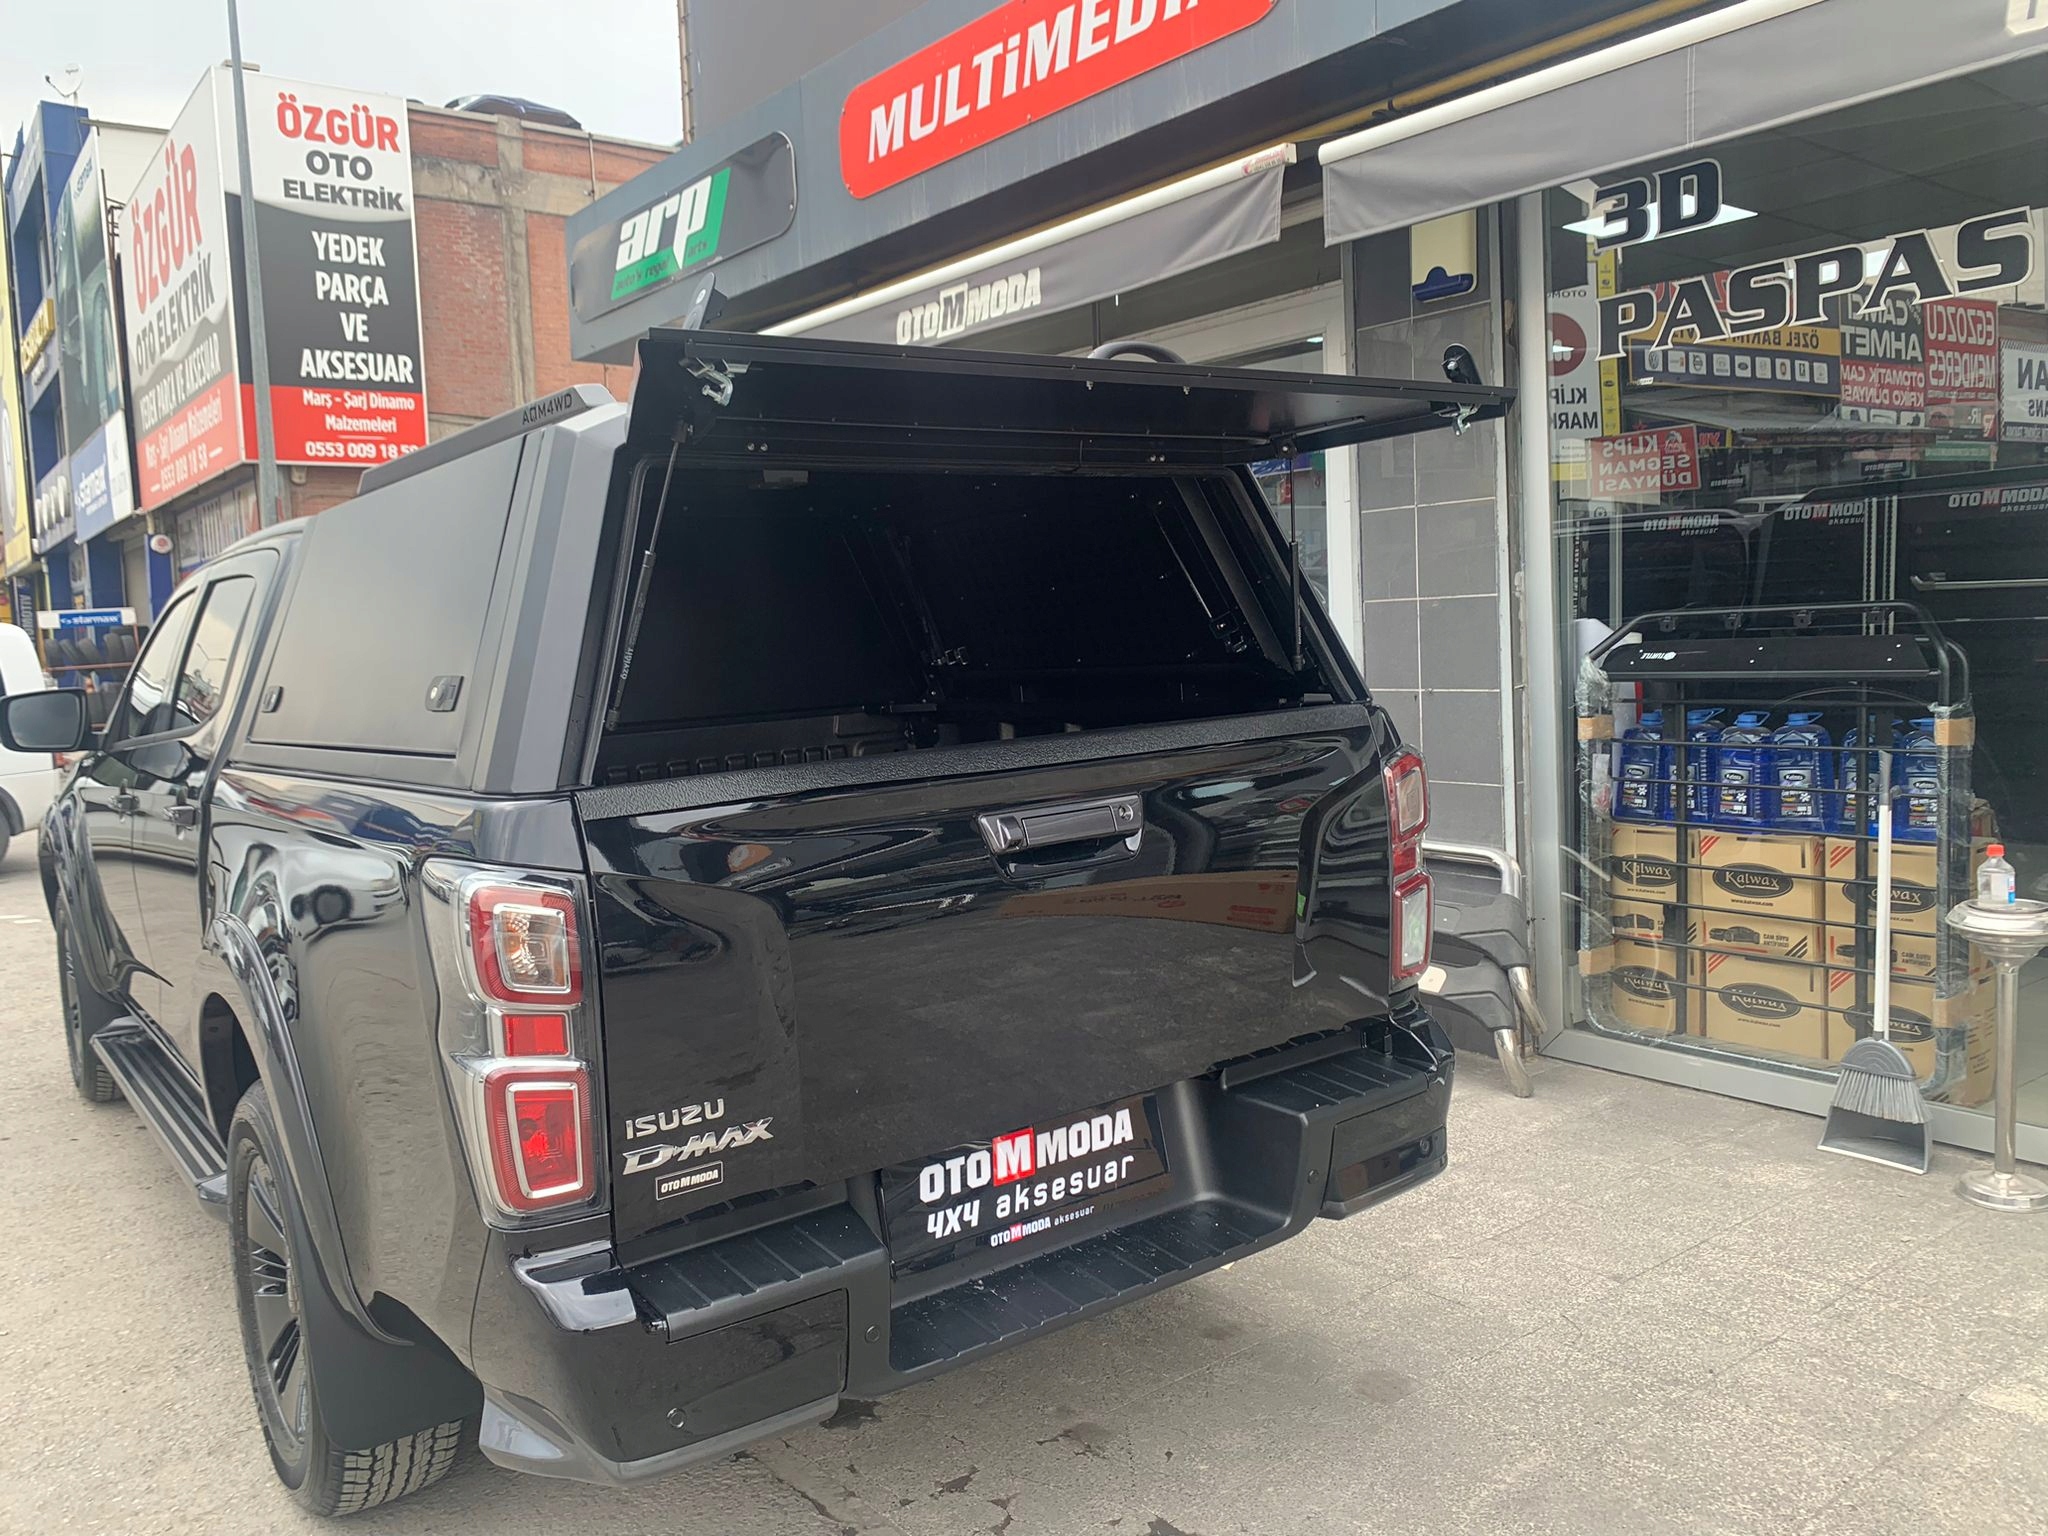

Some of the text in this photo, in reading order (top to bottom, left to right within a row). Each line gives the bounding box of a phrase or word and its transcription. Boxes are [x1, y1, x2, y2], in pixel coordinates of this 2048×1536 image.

[867, 0, 1200, 164] MULTiMED
[277, 92, 401, 153] ÖZGÜR
[305, 149, 373, 181] OTO
[283, 178, 404, 212] ELEKTRİK
[1592, 157, 1723, 254] 3D
[131, 139, 203, 315] ÖZGÜR
[615, 175, 712, 272] arp
[311, 230, 386, 267] YEDEK
[315, 270, 390, 309] PARÇA
[1594, 205, 2036, 361] PASPAS
[136, 251, 216, 376] OTO ELEKTRİK
[339, 312, 369, 343] VE
[300, 348, 415, 384] AKSESUAR
[302, 389, 333, 409] Marş
[343, 391, 369, 411] Şarj
[369, 392, 415, 411] Dinamo
[324, 414, 398, 433] Malzemeleri
[305, 441, 345, 457] 0553
[347, 442, 377, 458] 009
[380, 444, 399, 459] 18
[1621, 861, 1672, 880] Kalwax
[1724, 871, 1780, 890] Kalwax
[625, 1098, 725, 1140] ISUZU
[622, 1116, 775, 1176] D-MAX
[995, 1155, 1135, 1219] aksesuar
[1054, 1205, 1095, 1227] aksesuar
